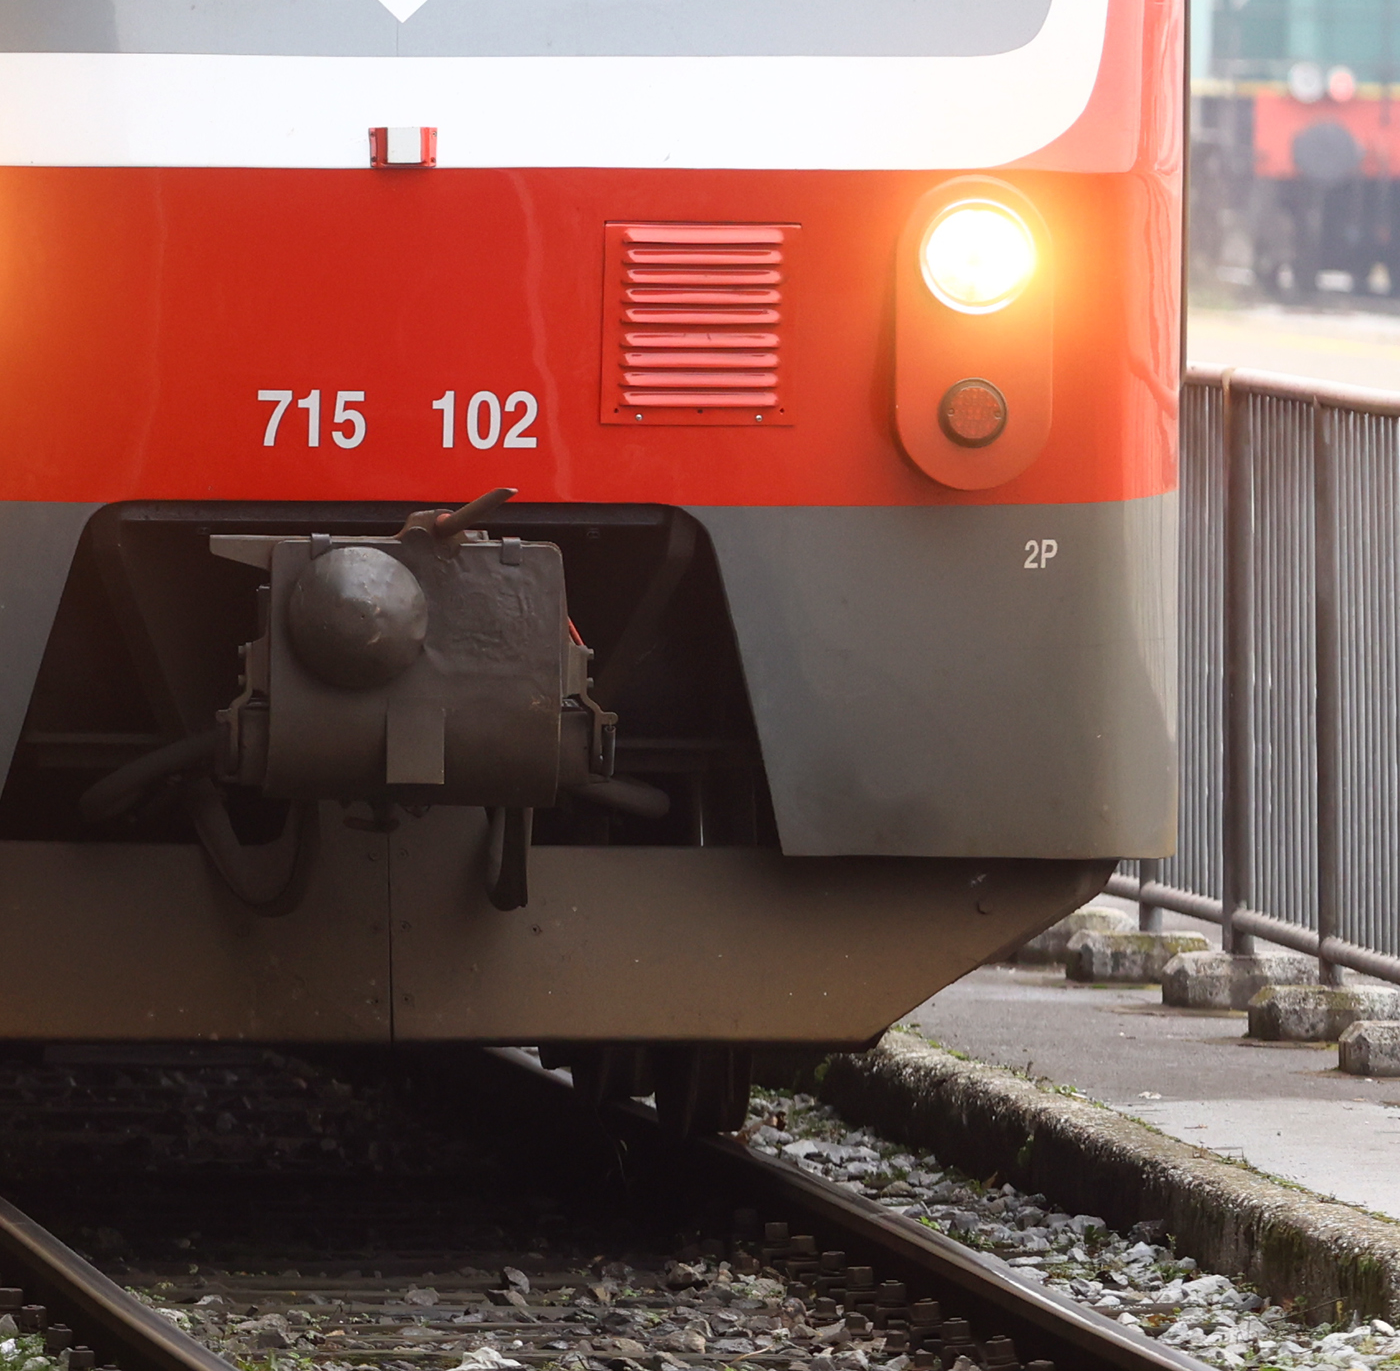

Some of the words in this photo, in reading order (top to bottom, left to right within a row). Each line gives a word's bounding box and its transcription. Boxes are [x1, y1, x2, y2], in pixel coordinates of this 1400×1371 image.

[256, 388, 367, 450] 715
[431, 389, 539, 451] 102
[1023, 538, 1059, 570] 2P
